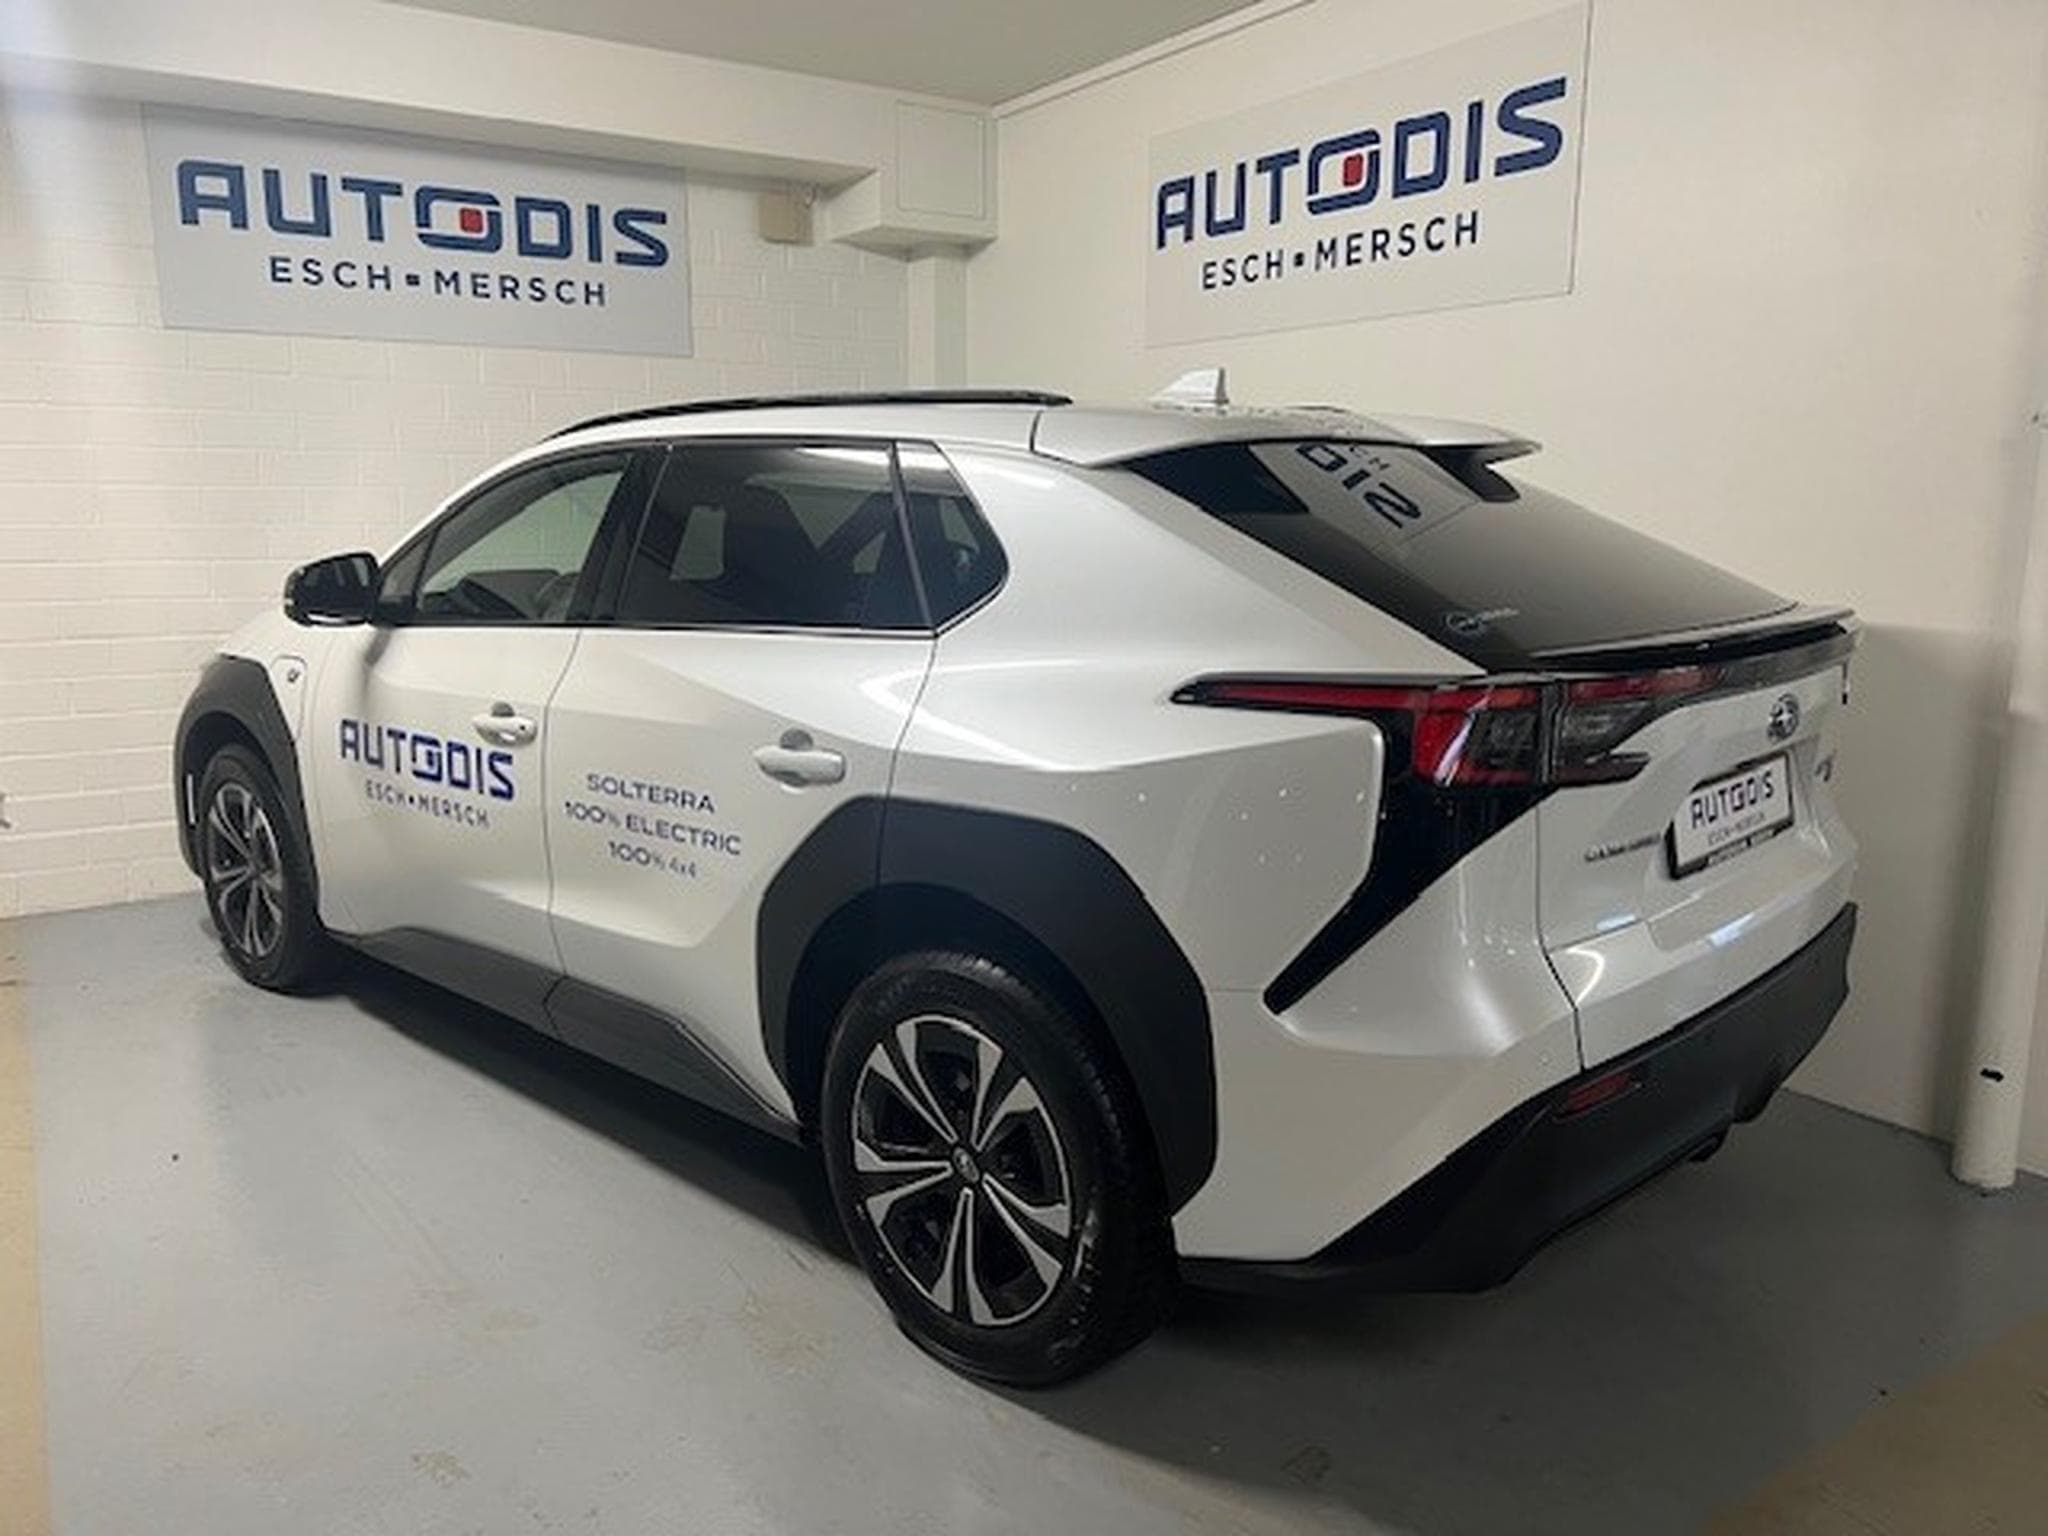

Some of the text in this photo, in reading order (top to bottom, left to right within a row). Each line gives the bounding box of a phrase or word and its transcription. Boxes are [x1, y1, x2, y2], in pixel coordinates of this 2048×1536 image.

[1157, 77, 1567, 249] AUTODIS
[177, 159, 669, 268] AUTODIS
[270, 256, 606, 306] ESCH MERSCH
[1202, 210, 1478, 289] ESCH MERSCH
[340, 719, 515, 801] AUTODIS
[366, 780, 490, 829] ESCH MERSCH
[587, 773, 715, 813] SOLTERRA
[626, 813, 742, 855] ELECTRIC
